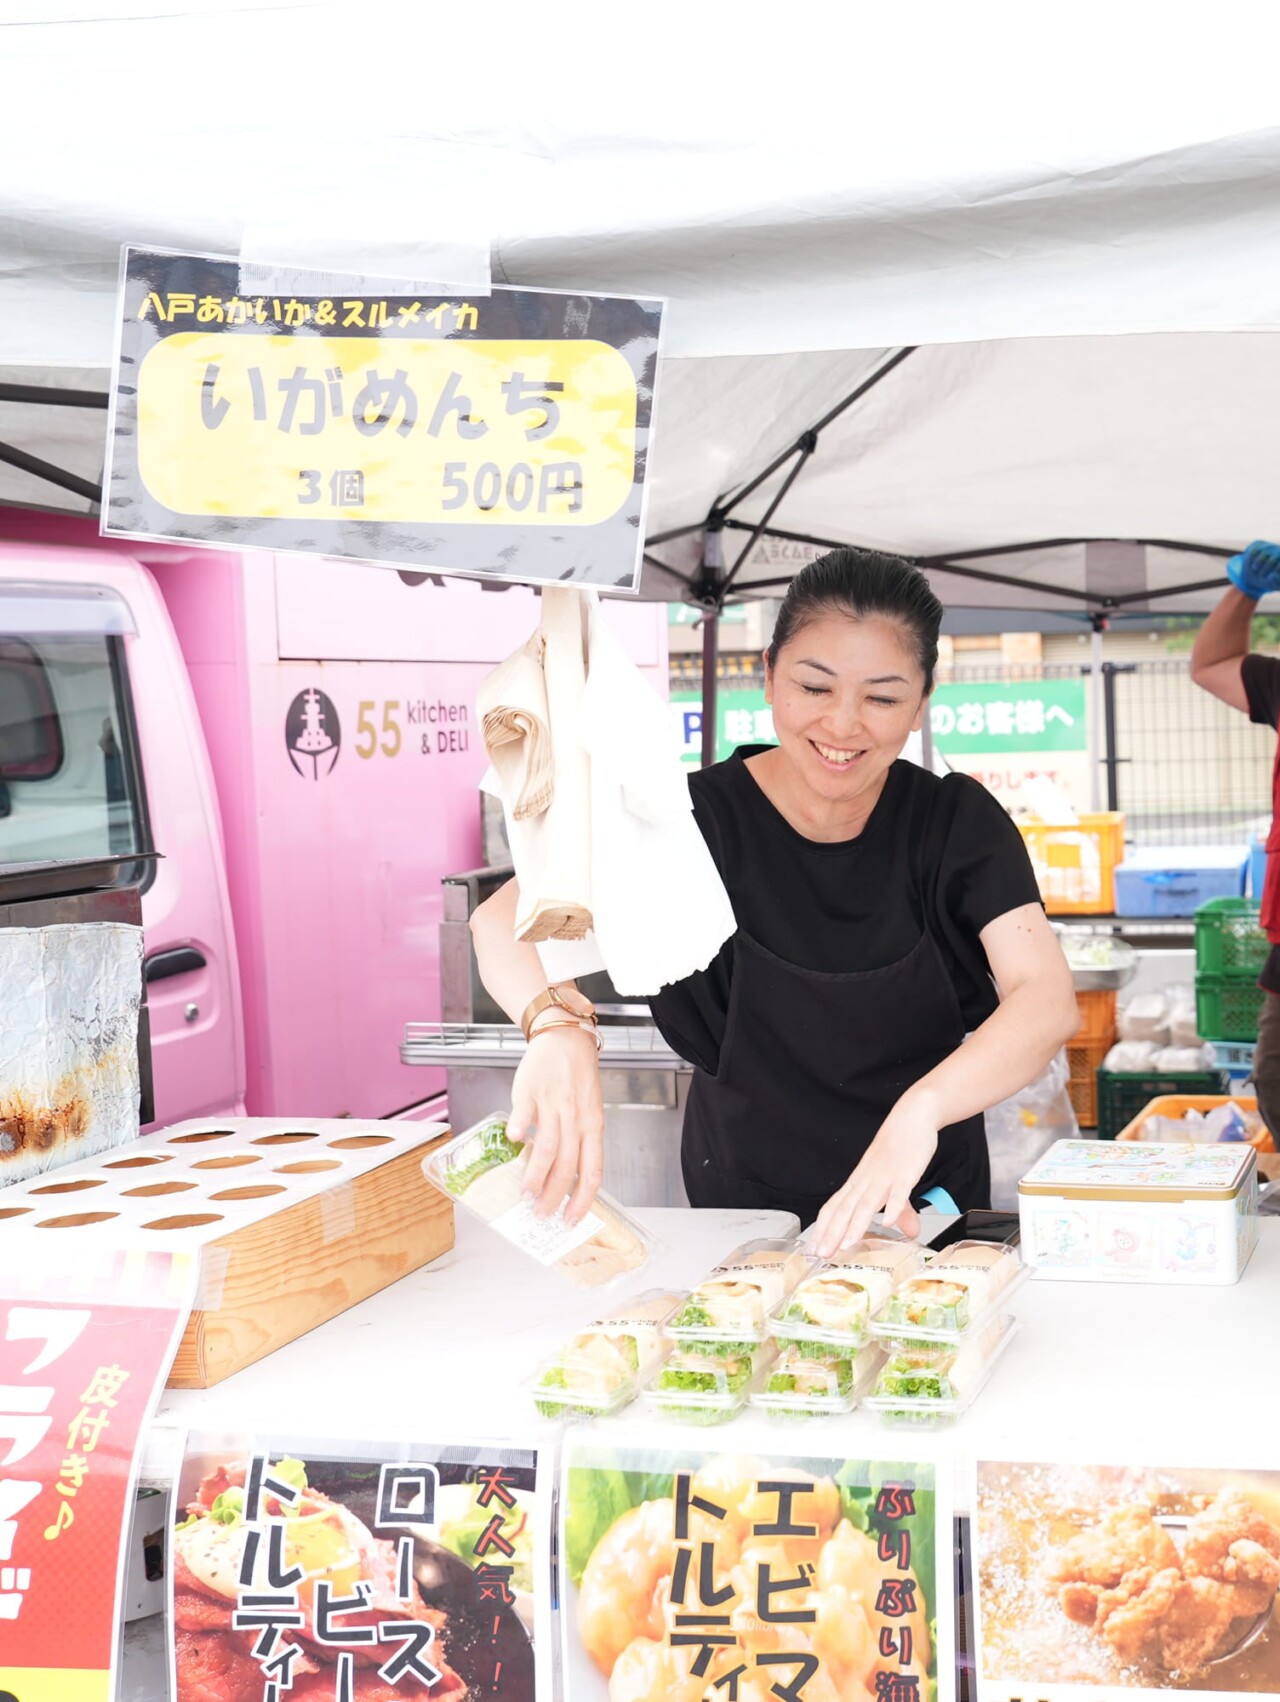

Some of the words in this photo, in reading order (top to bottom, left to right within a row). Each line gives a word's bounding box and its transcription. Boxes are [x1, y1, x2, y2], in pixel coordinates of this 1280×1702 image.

[199, 363, 565, 442] いがめんち
[297, 469, 365, 507] 3個
[441, 461, 584, 513] 500円
[355, 700, 401, 760] 55
[407, 699, 468, 723] kitchen
[422, 732, 431, 754] &
[438, 730, 468, 753] DELI
[55, 1364, 131, 1497] 皮付き
